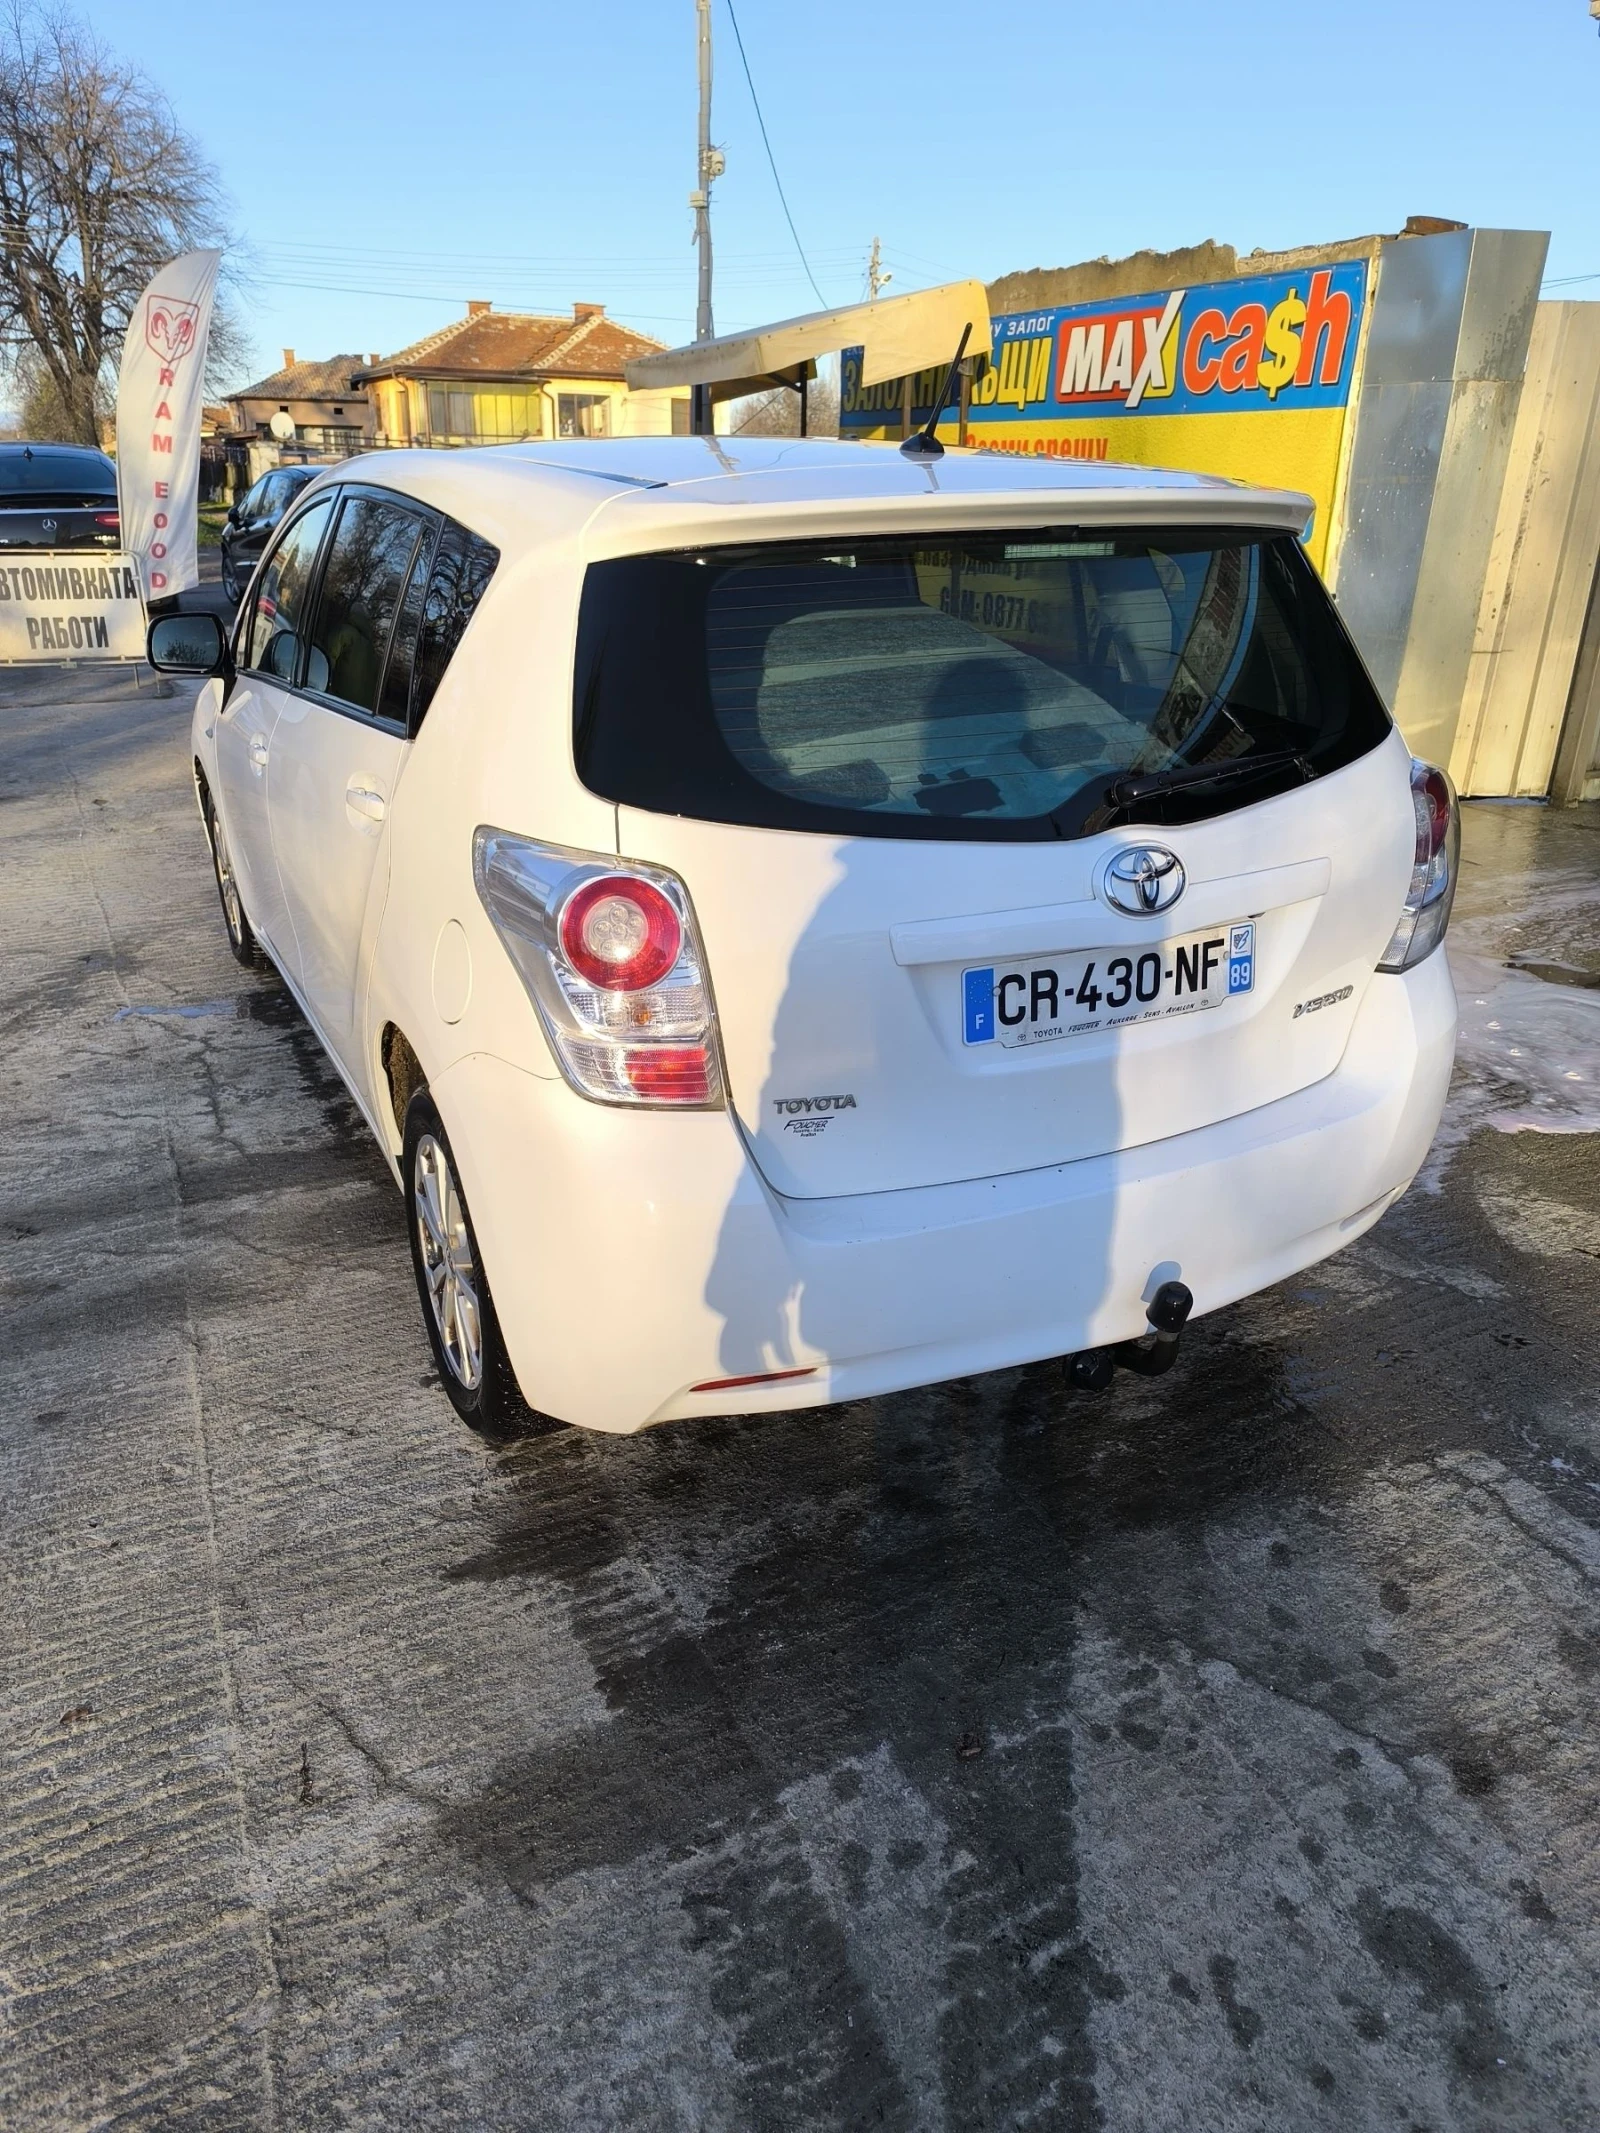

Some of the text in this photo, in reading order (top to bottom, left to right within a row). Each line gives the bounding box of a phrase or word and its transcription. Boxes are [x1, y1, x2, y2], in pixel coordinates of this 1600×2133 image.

[1007, 316, 1055, 336] ЗАЛОГ
[1060, 270, 1351, 408] MAX ca$h
[151, 368, 174, 589] RAM EOOD
[26, 616, 109, 649] РАБОТИ
[975, 938, 1225, 1029] F CR-430-NF
[1230, 962, 1250, 987] 89
[1033, 1027, 1063, 1039] TOYOTA
[1143, 1009, 1161, 1019] SENS
[1166, 1003, 1196, 1014] AVALLON
[773, 1094, 857, 1115] TOYOTA
[784, 1116, 835, 1130] FOUCHER
